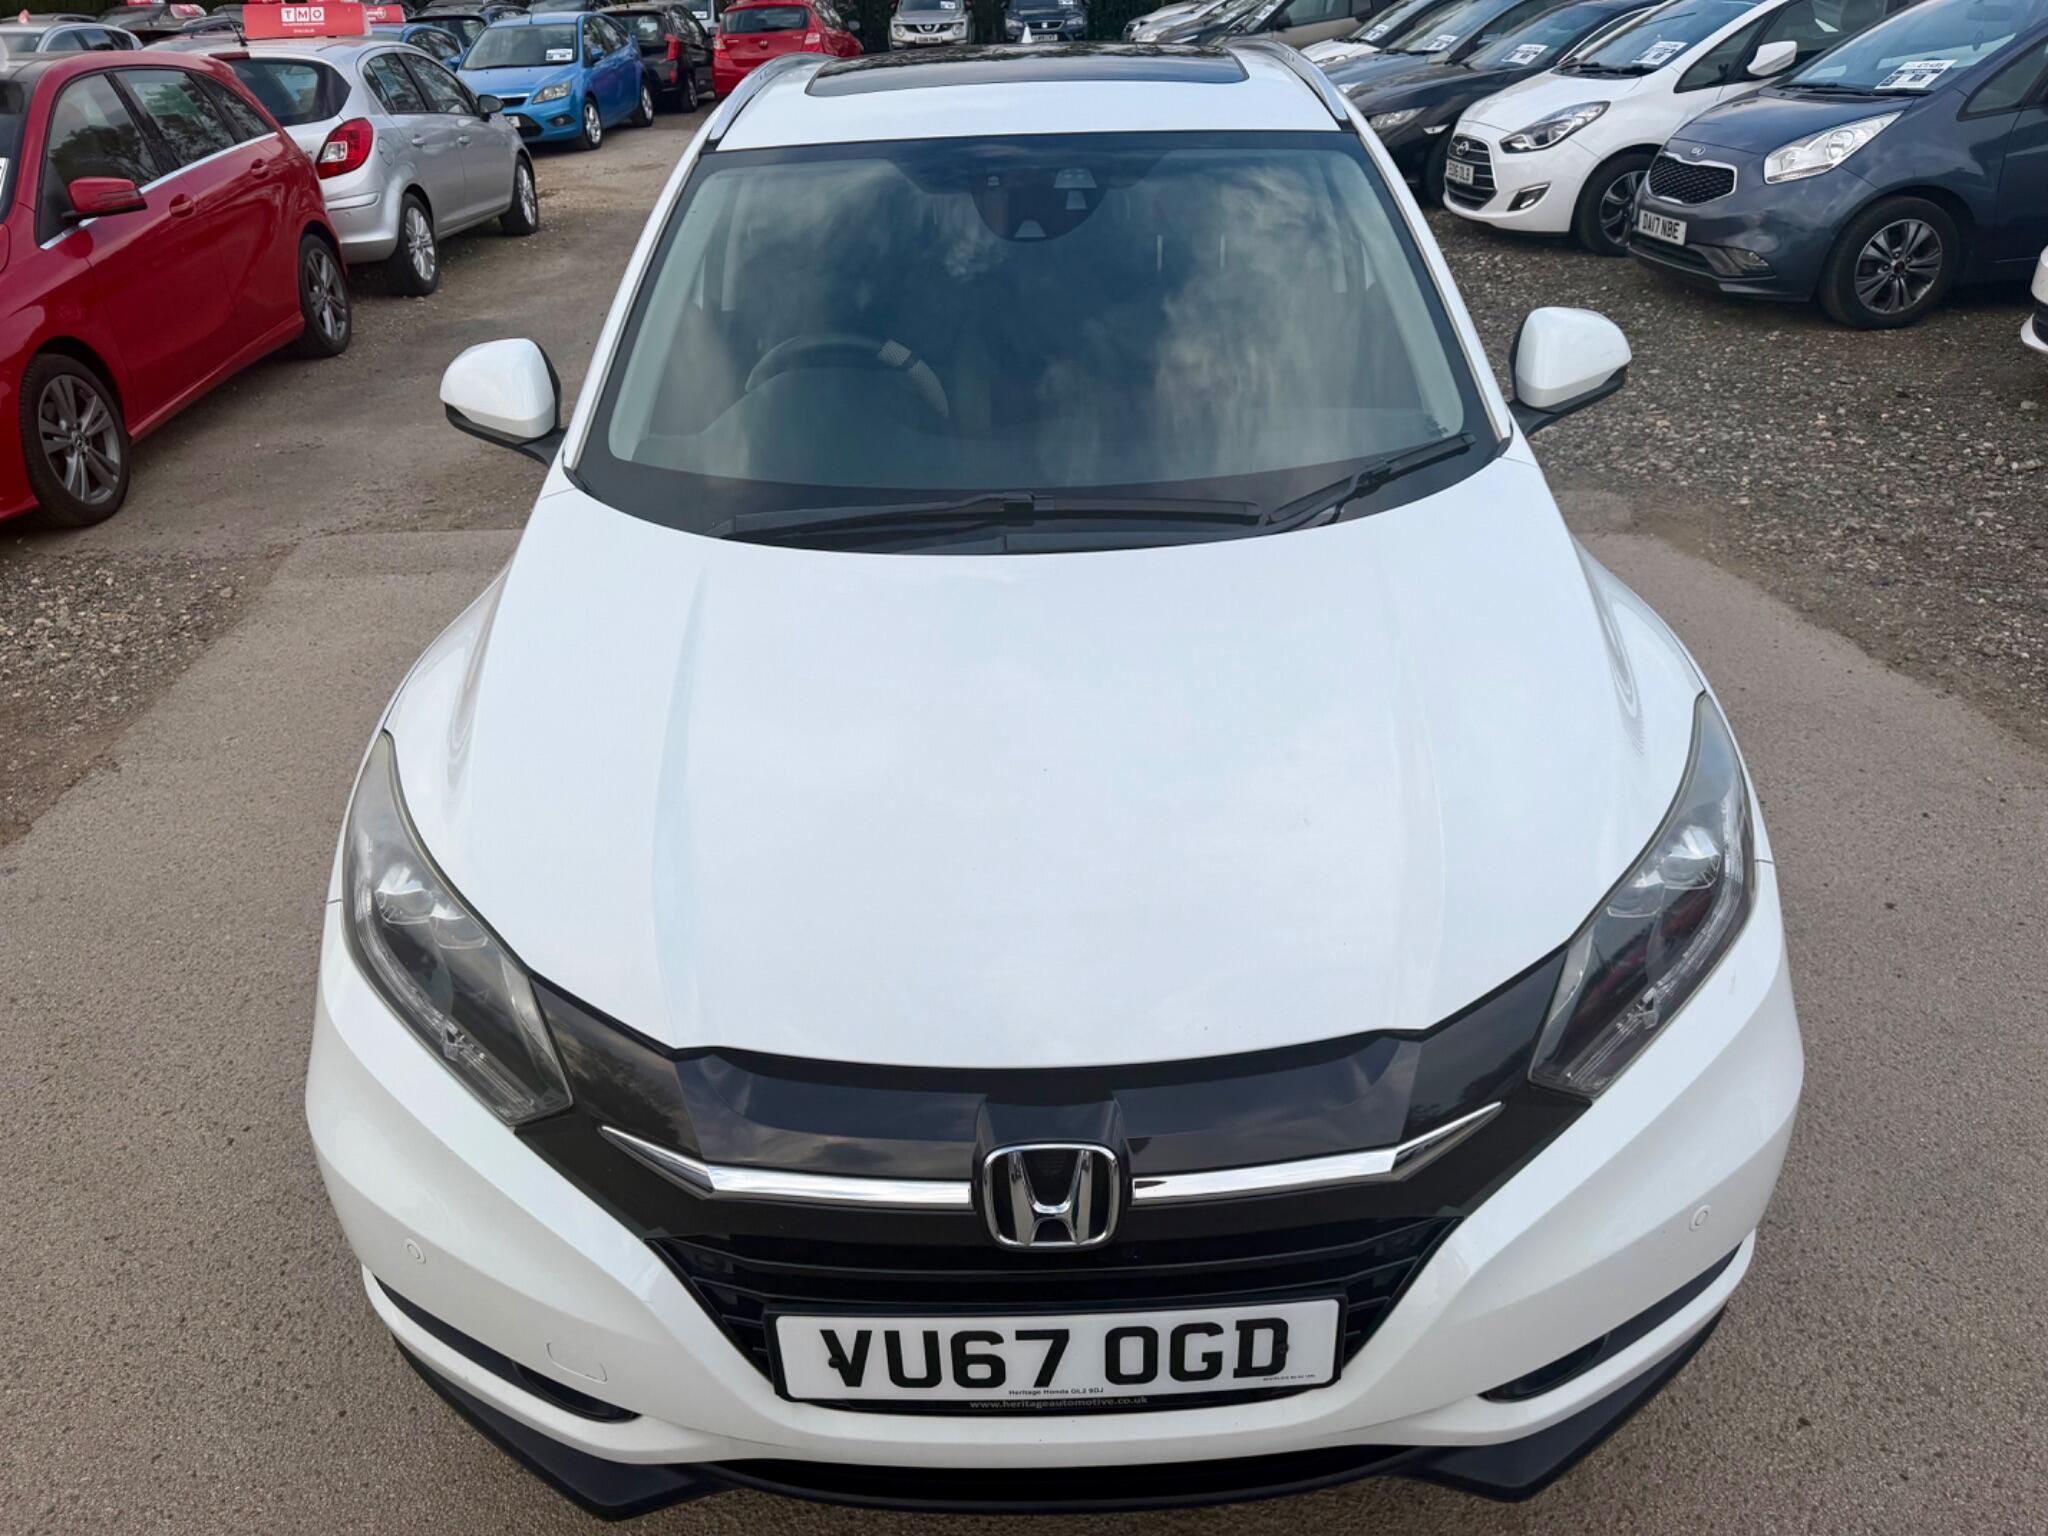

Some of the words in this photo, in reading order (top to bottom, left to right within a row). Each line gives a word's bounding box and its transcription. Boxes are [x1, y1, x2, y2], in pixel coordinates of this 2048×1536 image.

[283, 8, 323, 20] TMO
[1660, 218, 1680, 240] NBE
[819, 1328, 1070, 1389] VU67
[1104, 1317, 1290, 1386] OGD
[969, 1396, 1148, 1409] www.heritageautomotive.co.uk
